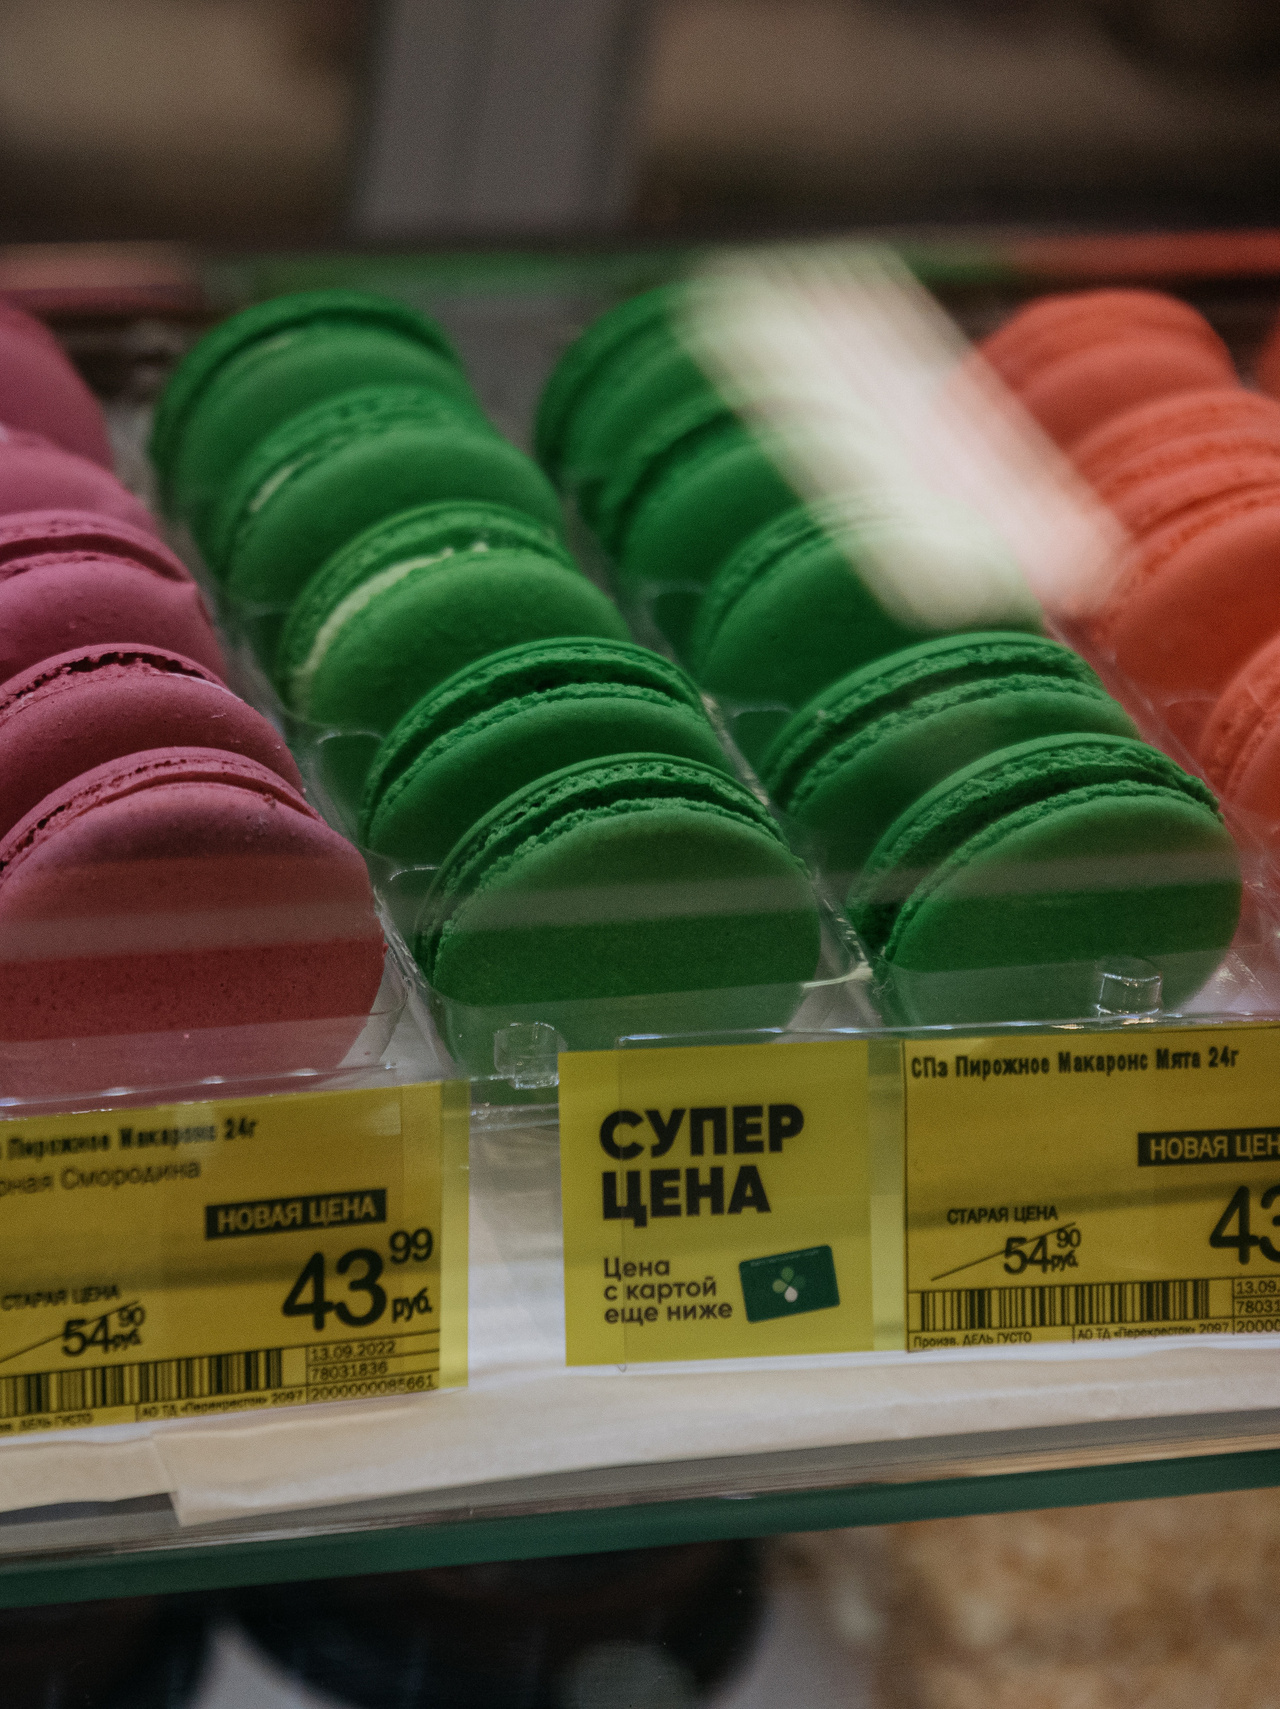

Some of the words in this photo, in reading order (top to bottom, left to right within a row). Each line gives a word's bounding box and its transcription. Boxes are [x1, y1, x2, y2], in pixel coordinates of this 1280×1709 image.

[955, 1056, 1051, 1081] Пирожное
[1057, 1052, 1148, 1076] Макаронс
[1155, 1049, 1201, 1070] Мята
[1208, 1047, 1239, 1068] 24г
[599, 1104, 804, 1160] СУПЕР
[1150, 1135, 1228, 1161] НОВАЯ
[61, 1160, 201, 1191] Смородина
[602, 1166, 771, 1228] ЦЕНА
[217, 1201, 302, 1232] НОВАЯ
[309, 1195, 377, 1225] ЦЕНА
[947, 1207, 1009, 1225] СТАРАЯ
[1015, 1205, 1058, 1223] ЦЕНА
[1004, 1236, 1048, 1275] 54
[1057, 1229, 1081, 1248] 90
[281, 1248, 388, 1333] 43
[388, 1228, 434, 1265] 99
[604, 1257, 670, 1281] Цена
[604, 1285, 618, 1300] с
[626, 1276, 716, 1303] картой
[604, 1306, 658, 1326] еще
[667, 1302, 733, 1320] ниже
[63, 1316, 109, 1357] 54
[310, 1340, 397, 1361] 13.09.2022
[963, 1334, 993, 1346] ДЕЛЬ
[997, 1331, 1032, 1343] ГУСТО
